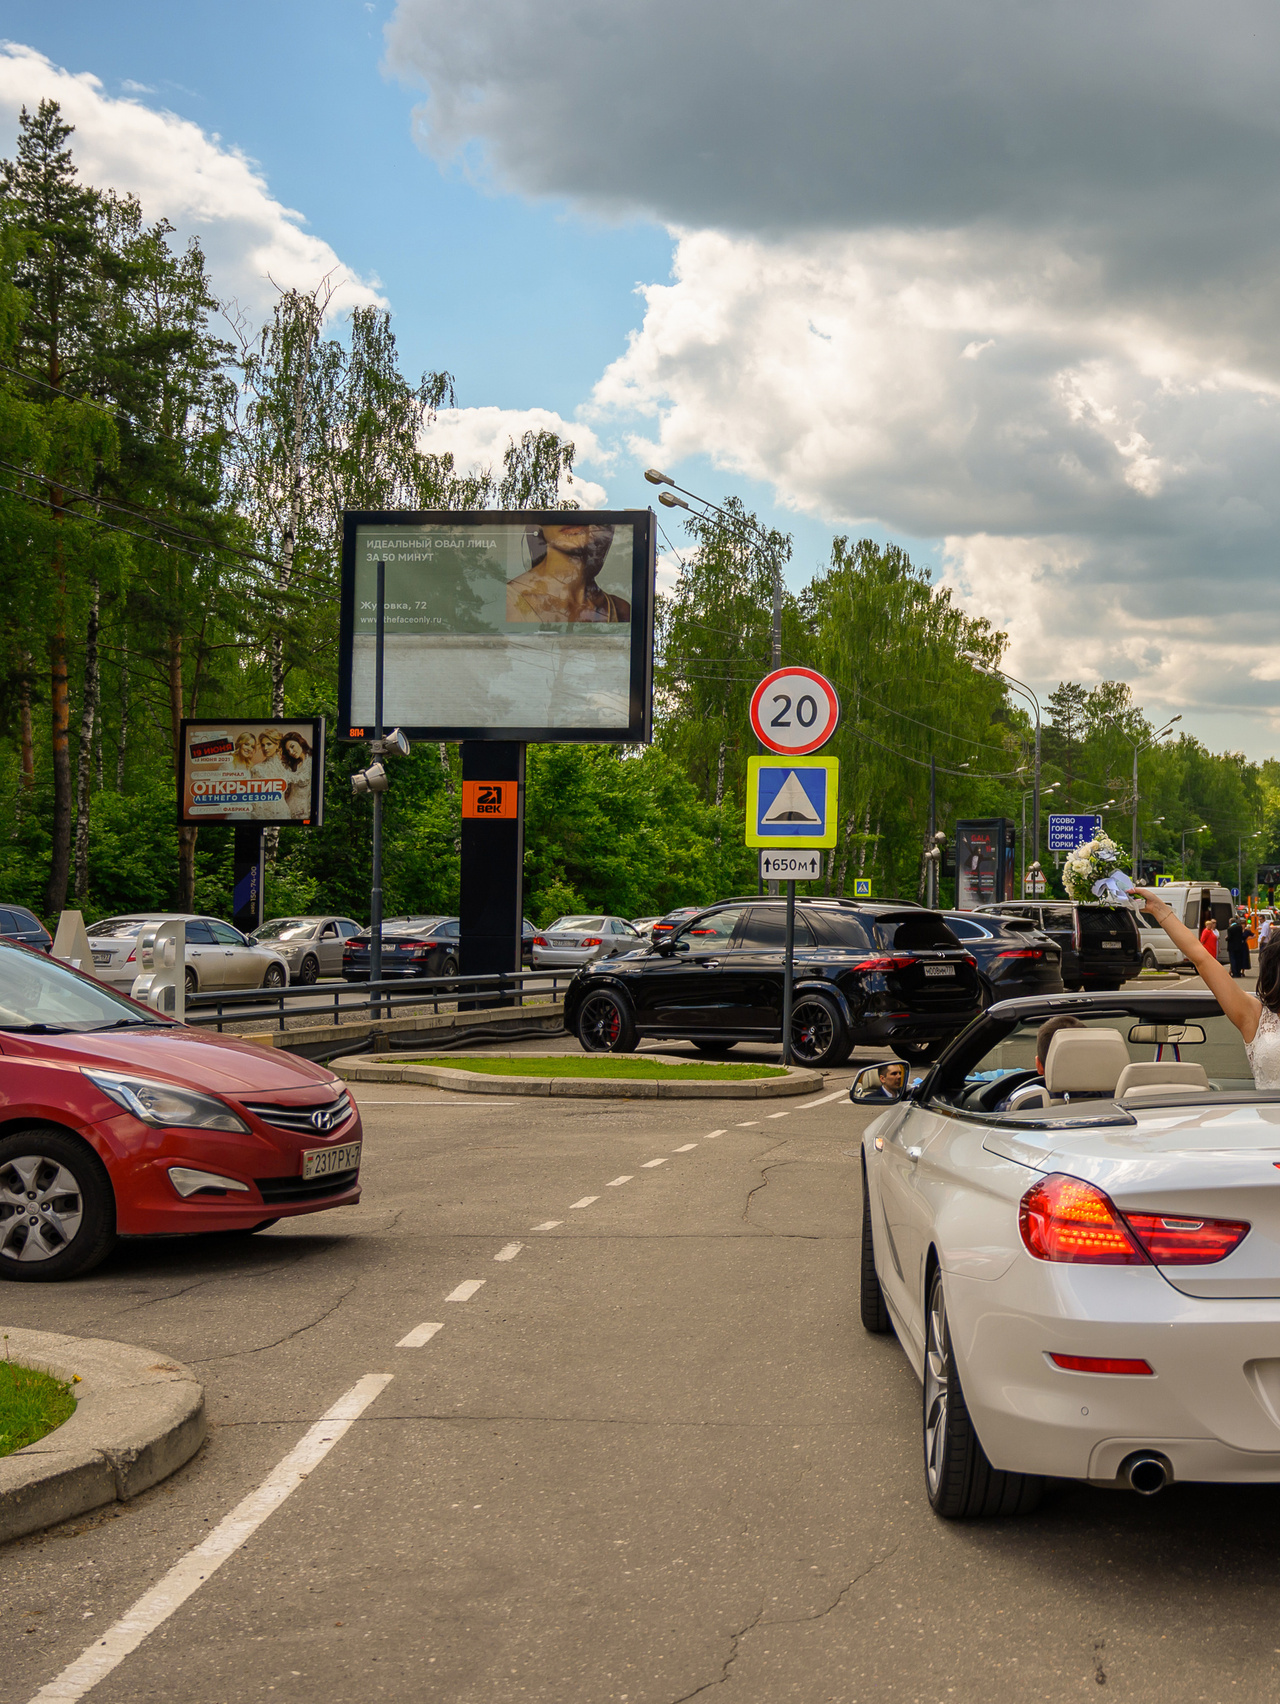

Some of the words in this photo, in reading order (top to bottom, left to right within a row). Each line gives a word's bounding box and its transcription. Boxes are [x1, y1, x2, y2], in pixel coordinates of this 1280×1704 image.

[366, 538, 432, 549] ИДЕАЛЬНЫЙ
[434, 540, 464, 548] ОВАЛ
[467, 540, 497, 549] ЛИЦА
[366, 553, 380, 562] ЗА
[382, 553, 396, 562] 50
[398, 553, 434, 562] МИНУТ
[360, 601, 412, 611] Жуовка,
[415, 601, 427, 610] 72
[770, 694, 818, 728] 20
[203, 743, 233, 755] ИЮНЯ
[193, 781, 283, 795] ОТКРЫТИЕ
[477, 786, 502, 804] 21
[971, 834, 990, 842] GALA
